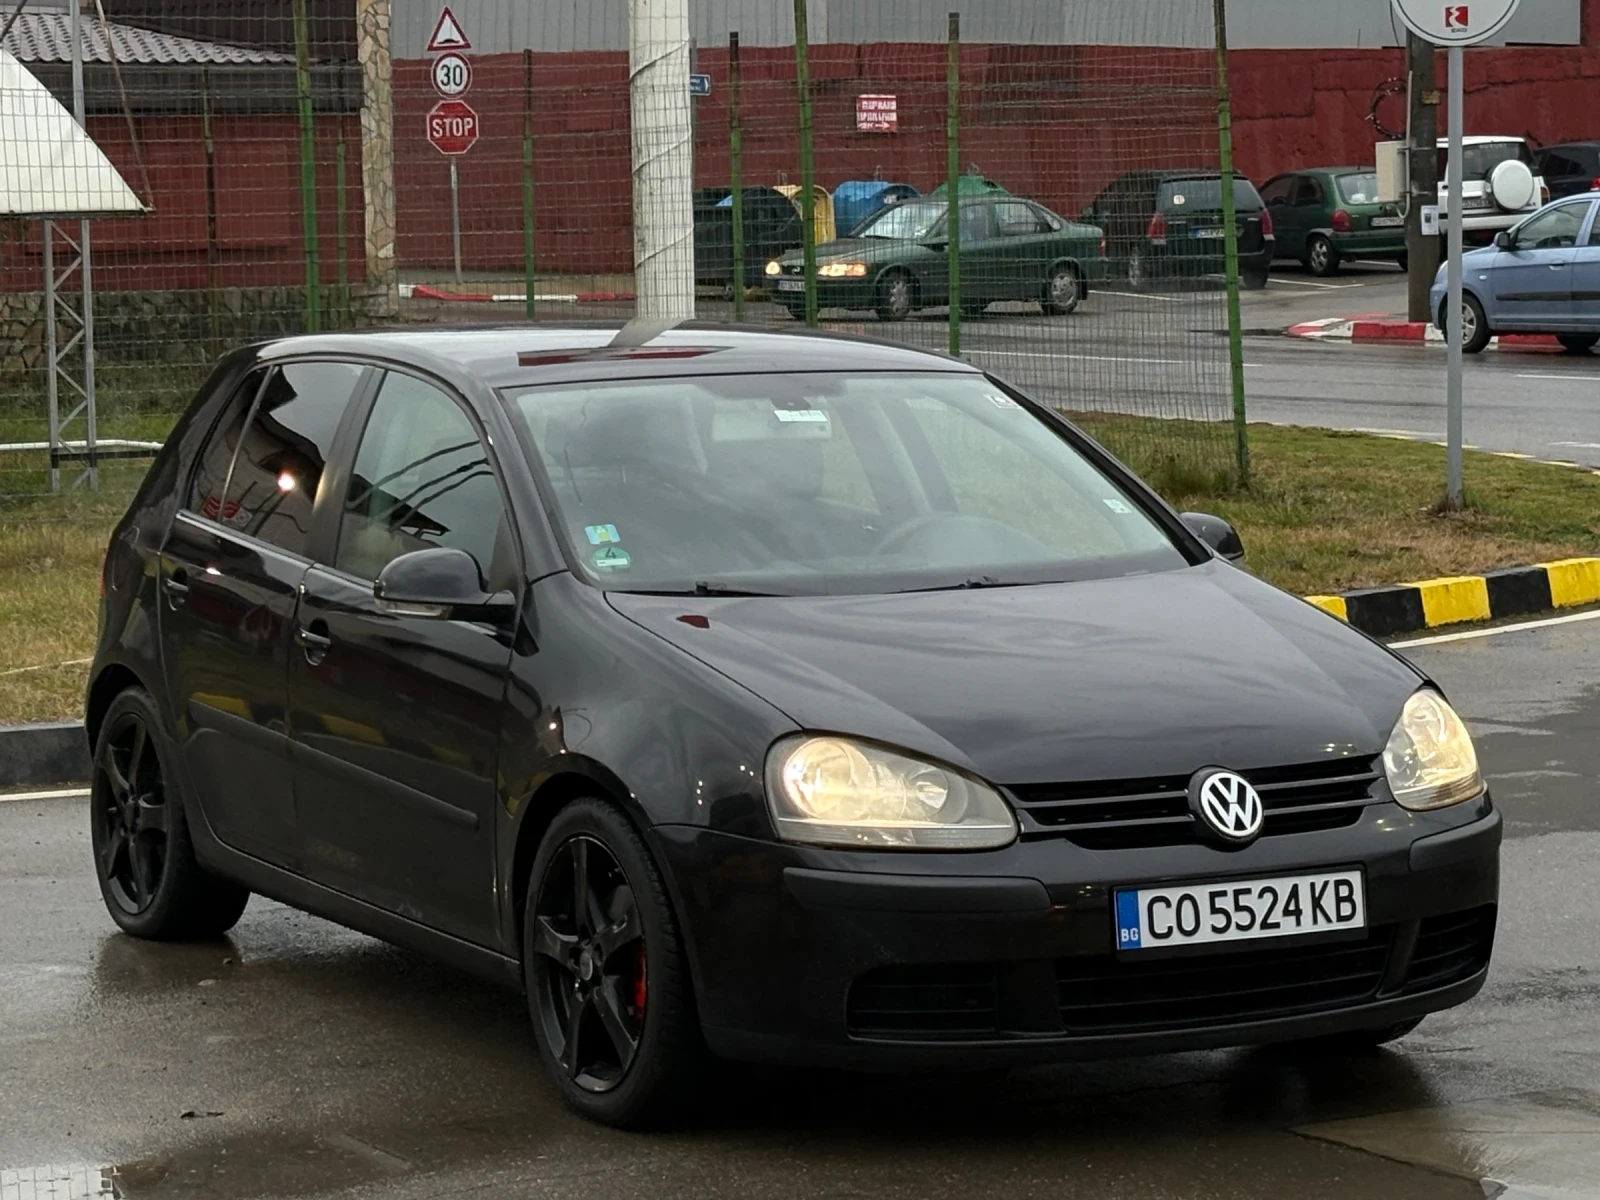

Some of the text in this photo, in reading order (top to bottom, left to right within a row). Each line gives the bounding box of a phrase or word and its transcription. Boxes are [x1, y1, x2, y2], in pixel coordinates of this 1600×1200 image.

[441, 64, 463, 87] 30
[432, 118, 474, 138] STOP
[1121, 928, 1139, 942] BG
